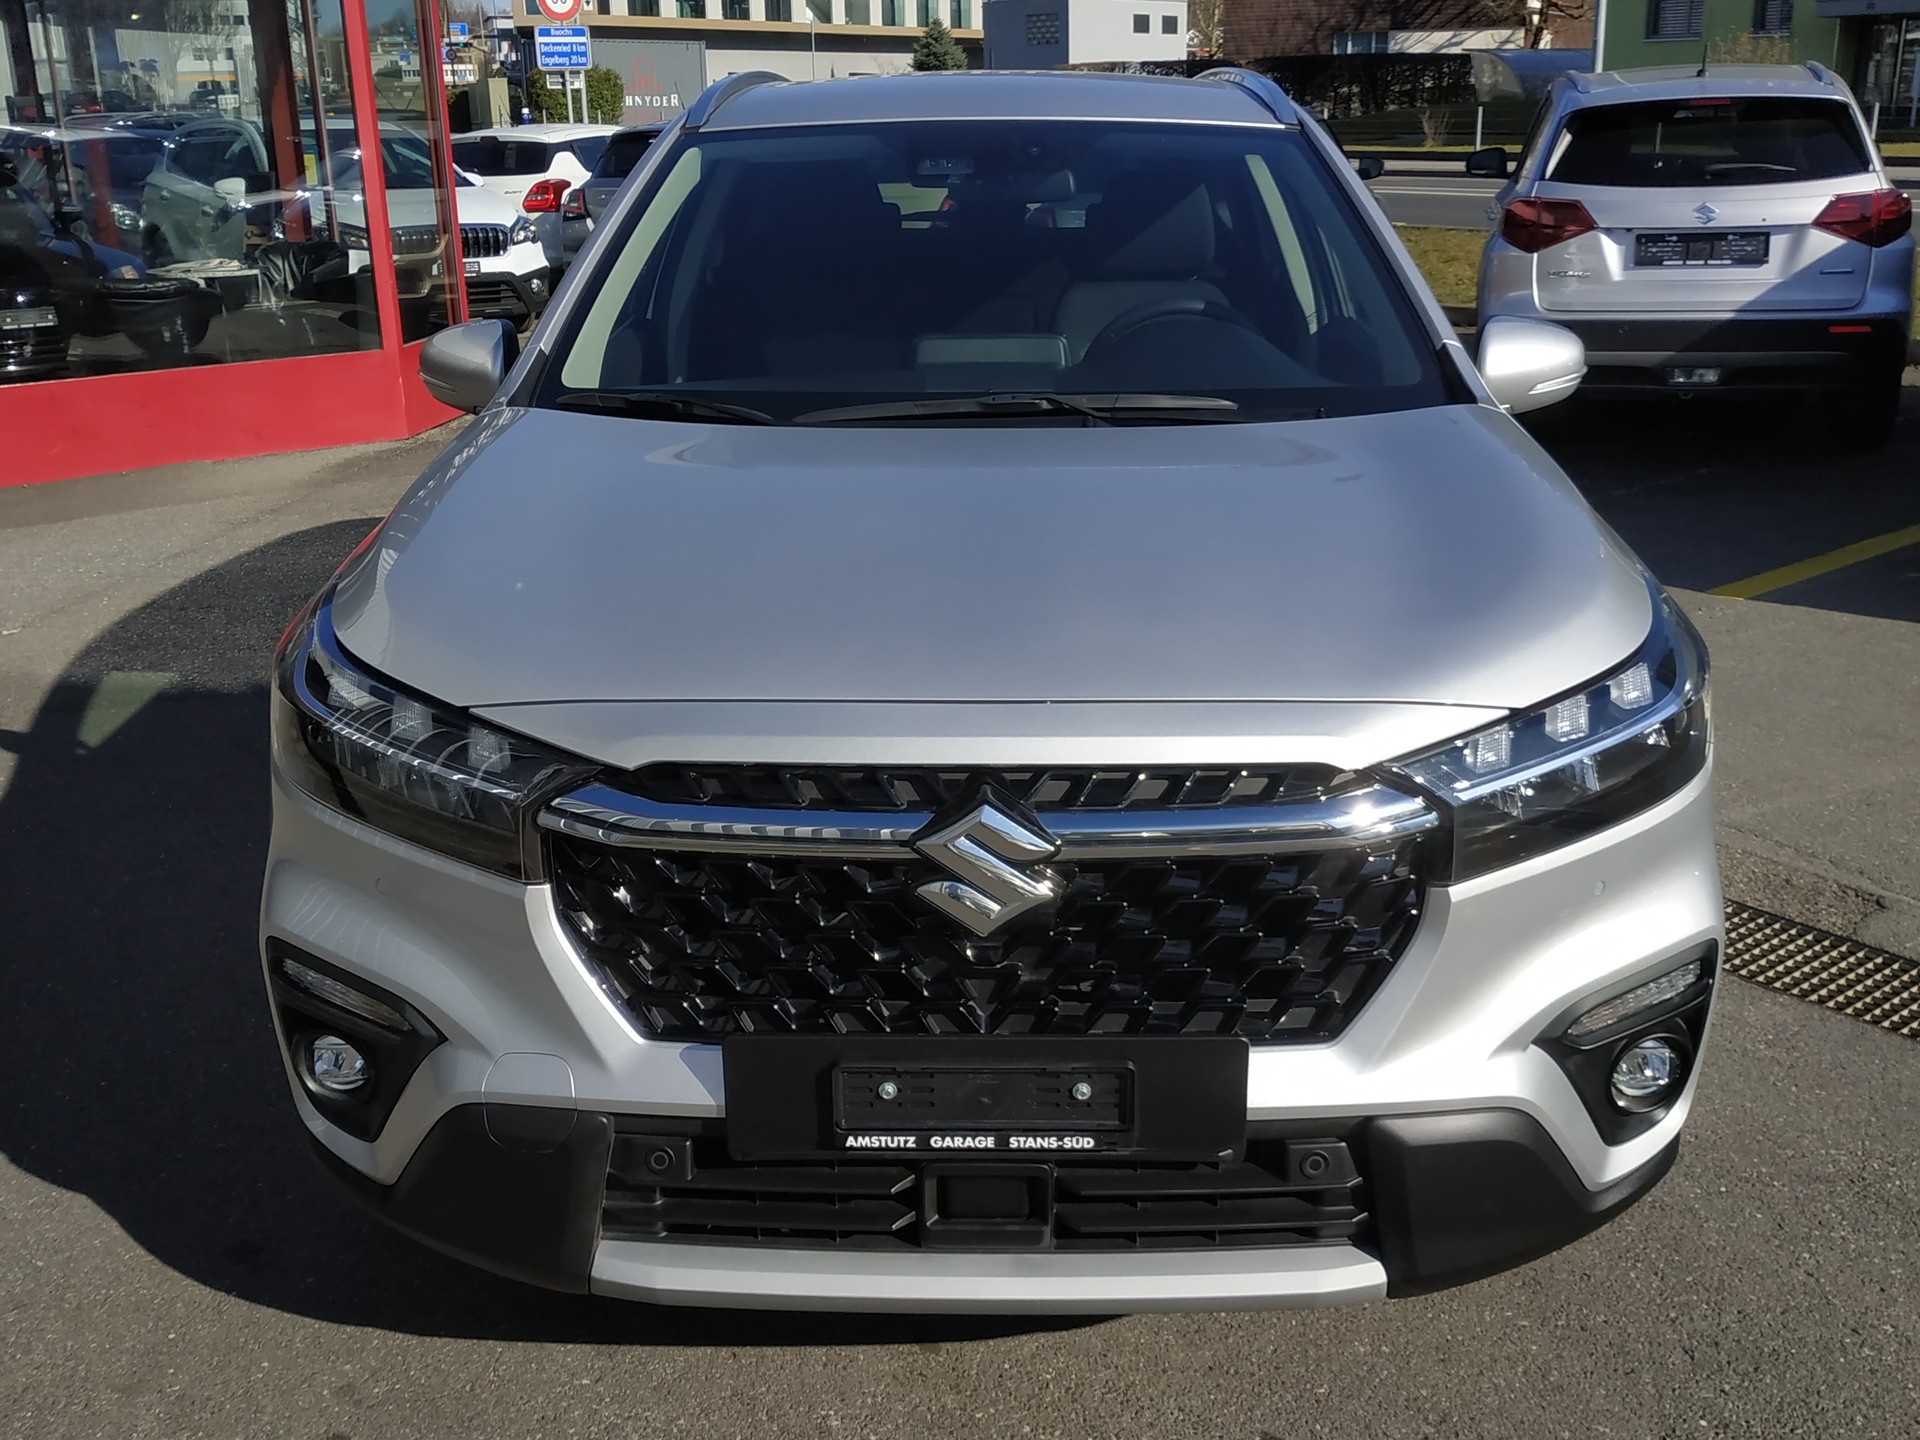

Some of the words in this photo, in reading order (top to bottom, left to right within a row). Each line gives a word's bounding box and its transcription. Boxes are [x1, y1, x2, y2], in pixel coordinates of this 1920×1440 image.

[540, 43, 571, 52] Beckenried
[572, 44, 577, 52] 8
[577, 44, 586, 52] km
[541, 55, 569, 66] Engelberg
[570, 55, 577, 64] 20
[578, 54, 587, 63] km
[620, 94, 679, 107] HNYDER
[845, 1136, 917, 1148] AMSTUTZ
[929, 1135, 995, 1148] GARAGE
[1009, 1135, 1095, 1148] STANS-SÜD
